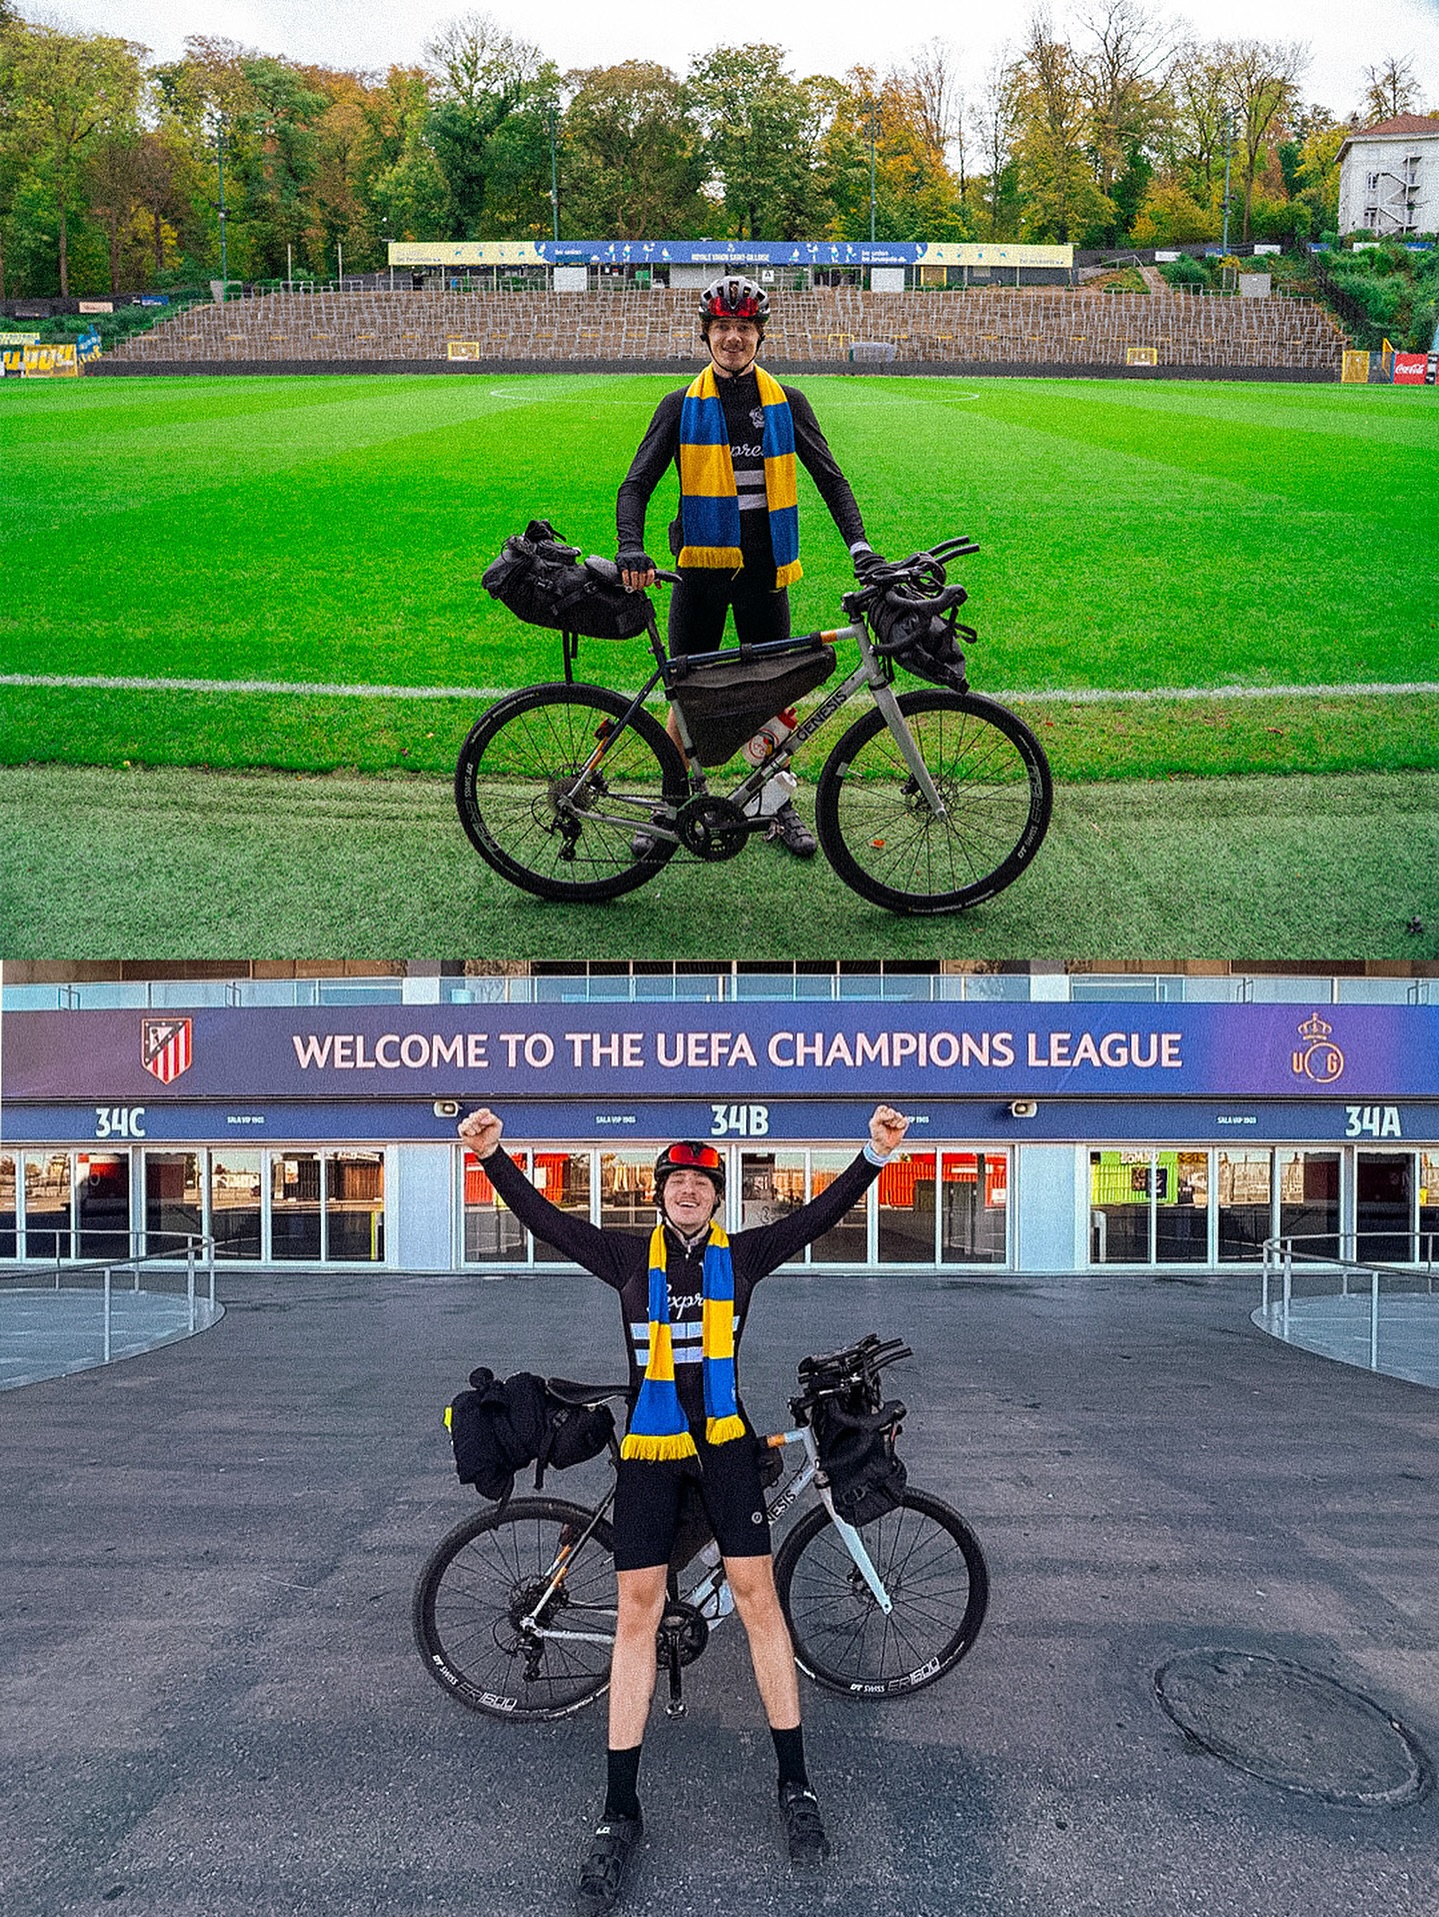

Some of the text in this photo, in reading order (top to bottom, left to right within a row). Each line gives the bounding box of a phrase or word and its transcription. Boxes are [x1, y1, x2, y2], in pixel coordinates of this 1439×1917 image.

[731, 443, 764, 457] pre
[796, 691, 847, 741] GENESIS
[292, 1032, 1184, 1069] WELCOME TO THE UEFA CHAMPIONS LEAGUE
[95, 1107, 146, 1138] 34C
[711, 1104, 769, 1136] 34B
[1345, 1106, 1402, 1137] 34A
[767, 1490, 796, 1522] NESIS
[432, 1654, 444, 1666] DT
[850, 1683, 863, 1691] DT
[864, 1685, 885, 1693] SWISS
